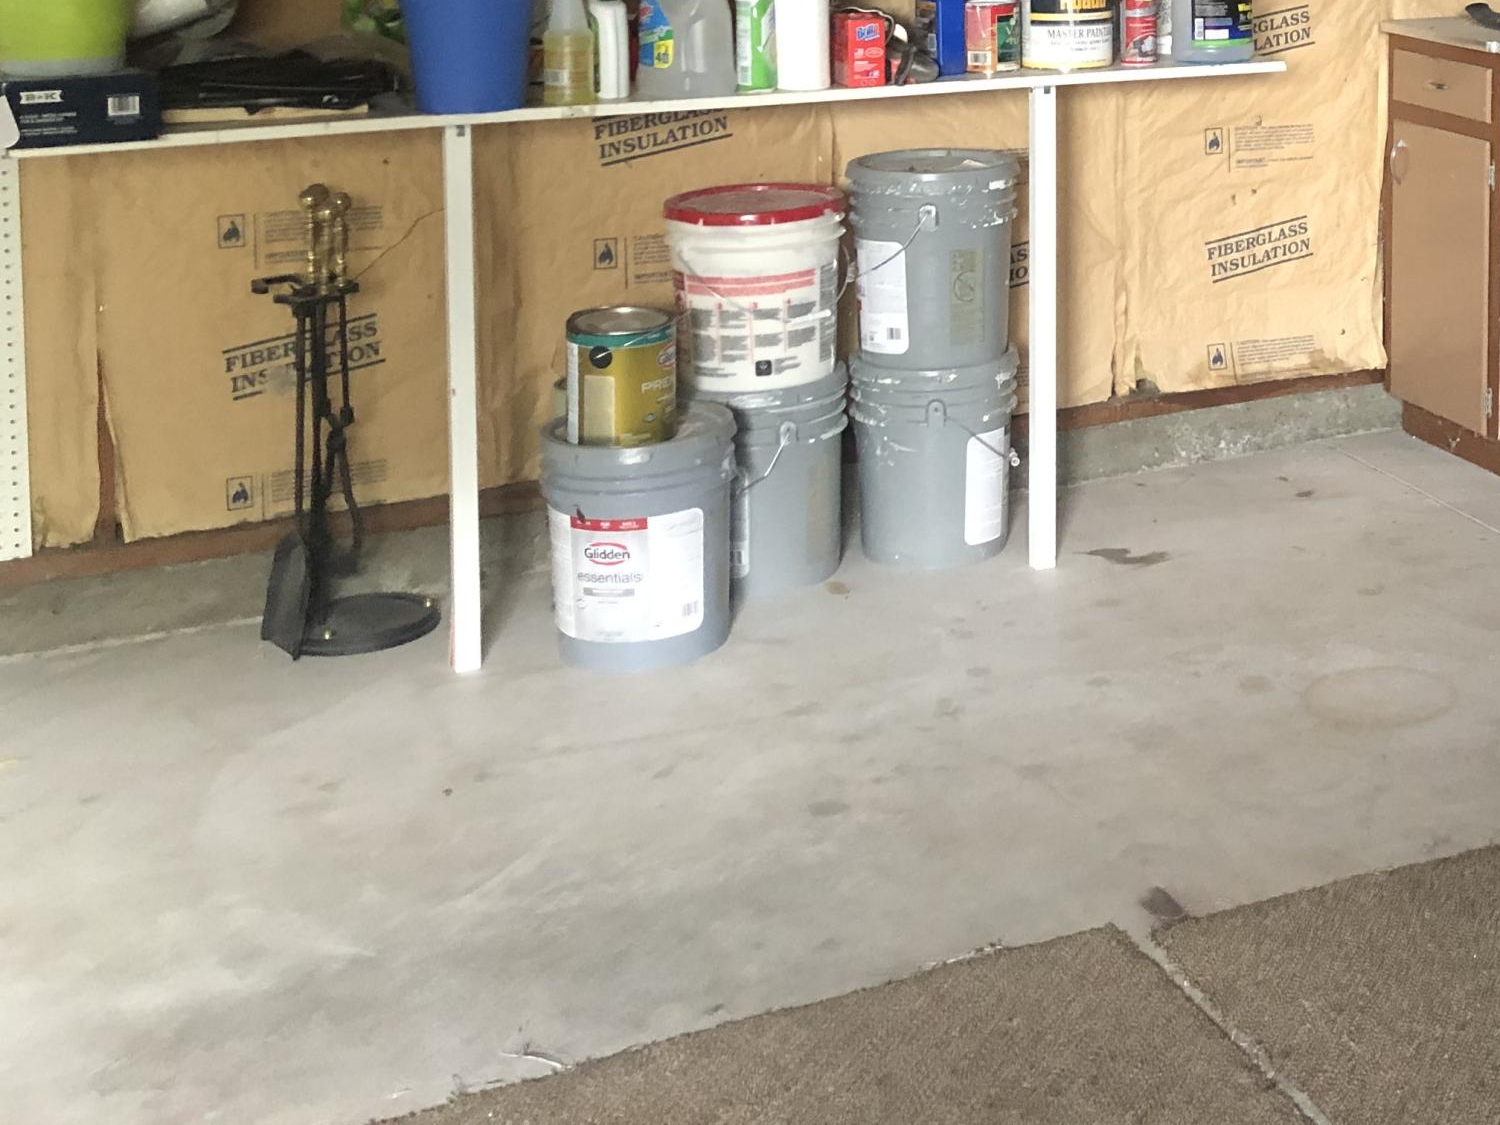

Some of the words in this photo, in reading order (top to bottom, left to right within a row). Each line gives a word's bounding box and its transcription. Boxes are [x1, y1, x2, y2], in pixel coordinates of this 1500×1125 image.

[599, 116, 728, 159] INSULATION
[1207, 221, 1309, 260] FIBERGLASS
[1211, 238, 1311, 276] INSULATION
[584, 546, 631, 560] Glidden
[577, 571, 643, 585] essentials
